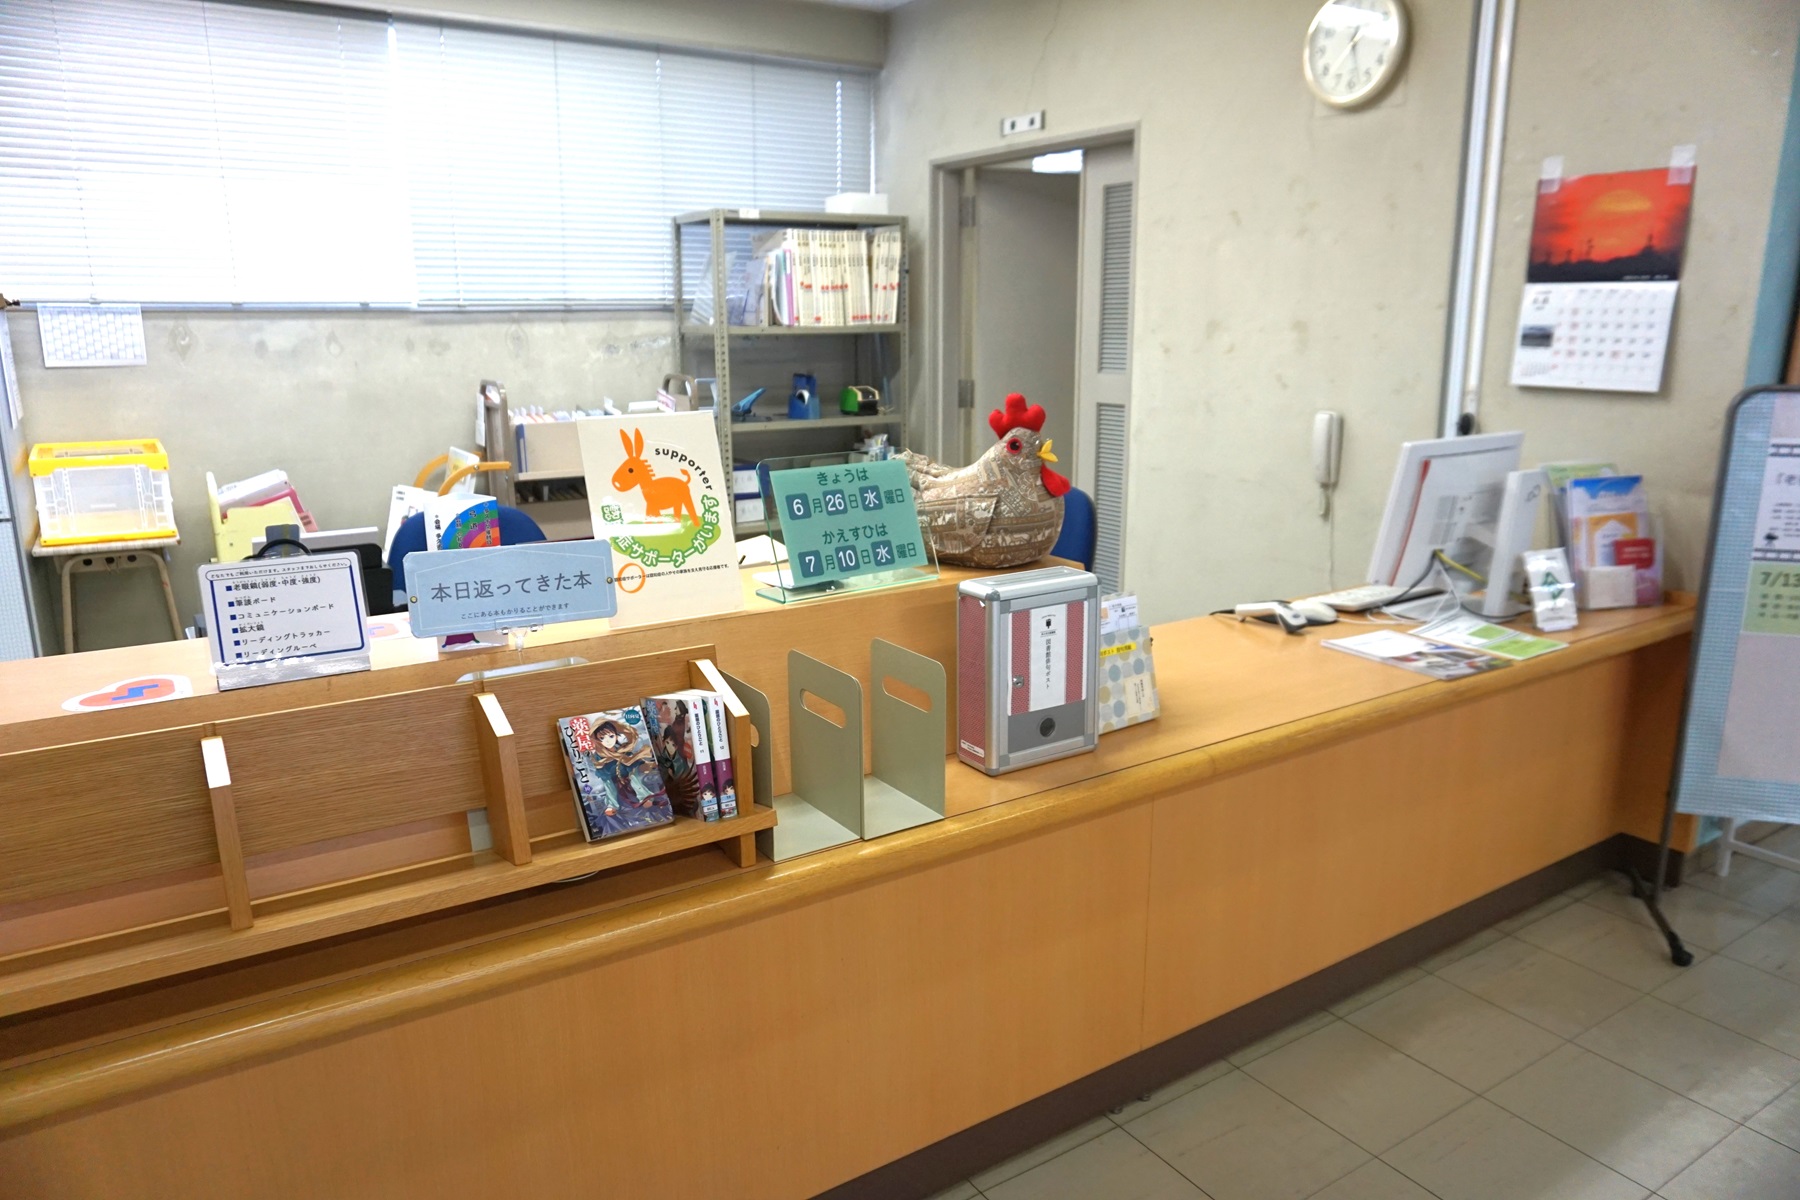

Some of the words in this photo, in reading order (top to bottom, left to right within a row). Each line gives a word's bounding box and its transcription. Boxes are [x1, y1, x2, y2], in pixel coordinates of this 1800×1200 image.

[655, 447, 713, 491] supporter
[817, 467, 869, 486] きょうは
[792, 488, 905, 516] 6月26日水曜日
[601, 496, 719, 567] 認症サポーターがいます
[822, 523, 888, 545] かえすひは
[805, 542, 917, 573] 7月10日水曜日
[431, 571, 592, 602] 本日返ってきた本
[235, 597, 276, 606] 筆談ボード
[238, 603, 334, 620] コミュニケーションボード
[461, 603, 570, 620] ここにある本もかりることができます
[239, 624, 265, 634] 拡大鏡
[242, 631, 330, 646] リーディングトラッカー
[564, 726, 590, 784] ひとりごと
